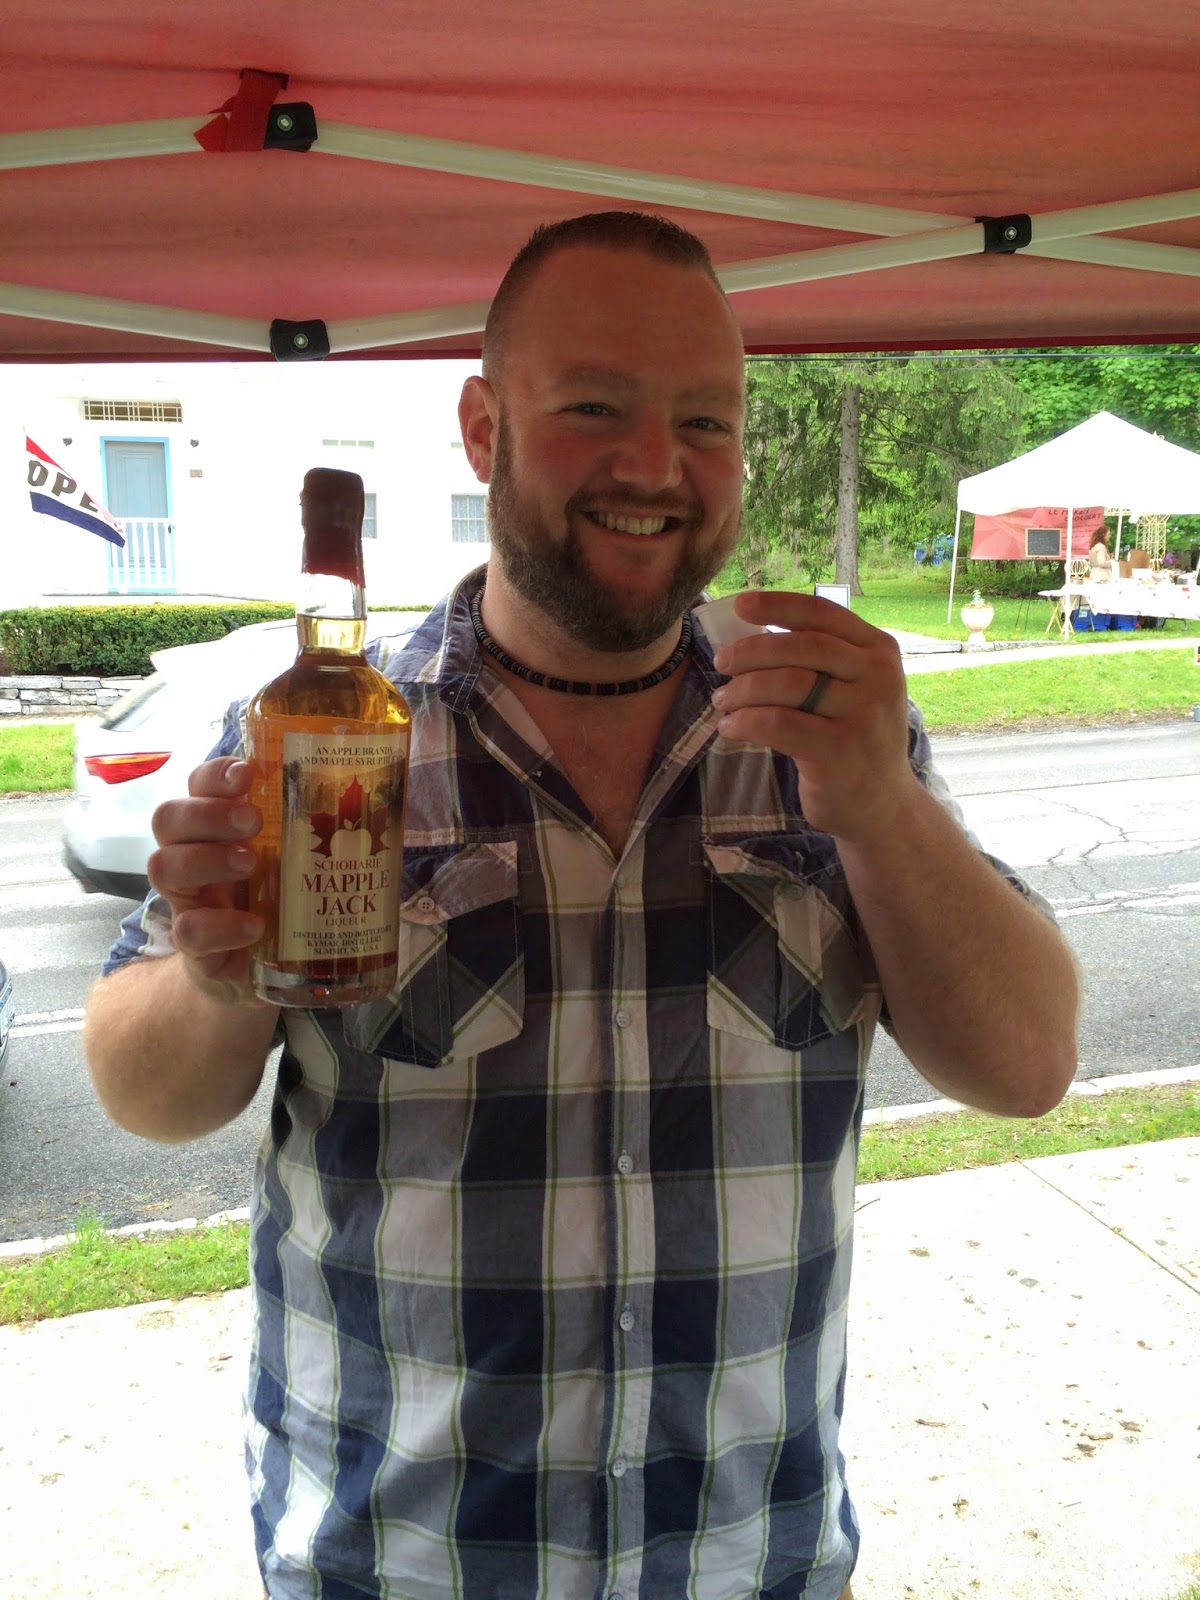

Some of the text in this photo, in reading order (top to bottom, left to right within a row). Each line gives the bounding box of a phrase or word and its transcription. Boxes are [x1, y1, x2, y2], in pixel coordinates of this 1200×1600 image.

[1064, 513, 1101, 522] COCOLAT
[316, 746, 393, 756] AN APPLE BRANDY
[299, 756, 318, 765] AND
[318, 756, 354, 766] MAPLE
[355, 756, 383, 766] SYRUP
[314, 858, 381, 871] SCHOHARIE
[300, 870, 390, 893] MAPPLE
[316, 893, 378, 916] JACK
[325, 916, 367, 928] LIQUEUR
[292, 931, 336, 940] DISTILLED
[338, 931, 354, 940] AND
[307, 939, 339, 948] KYMAR
